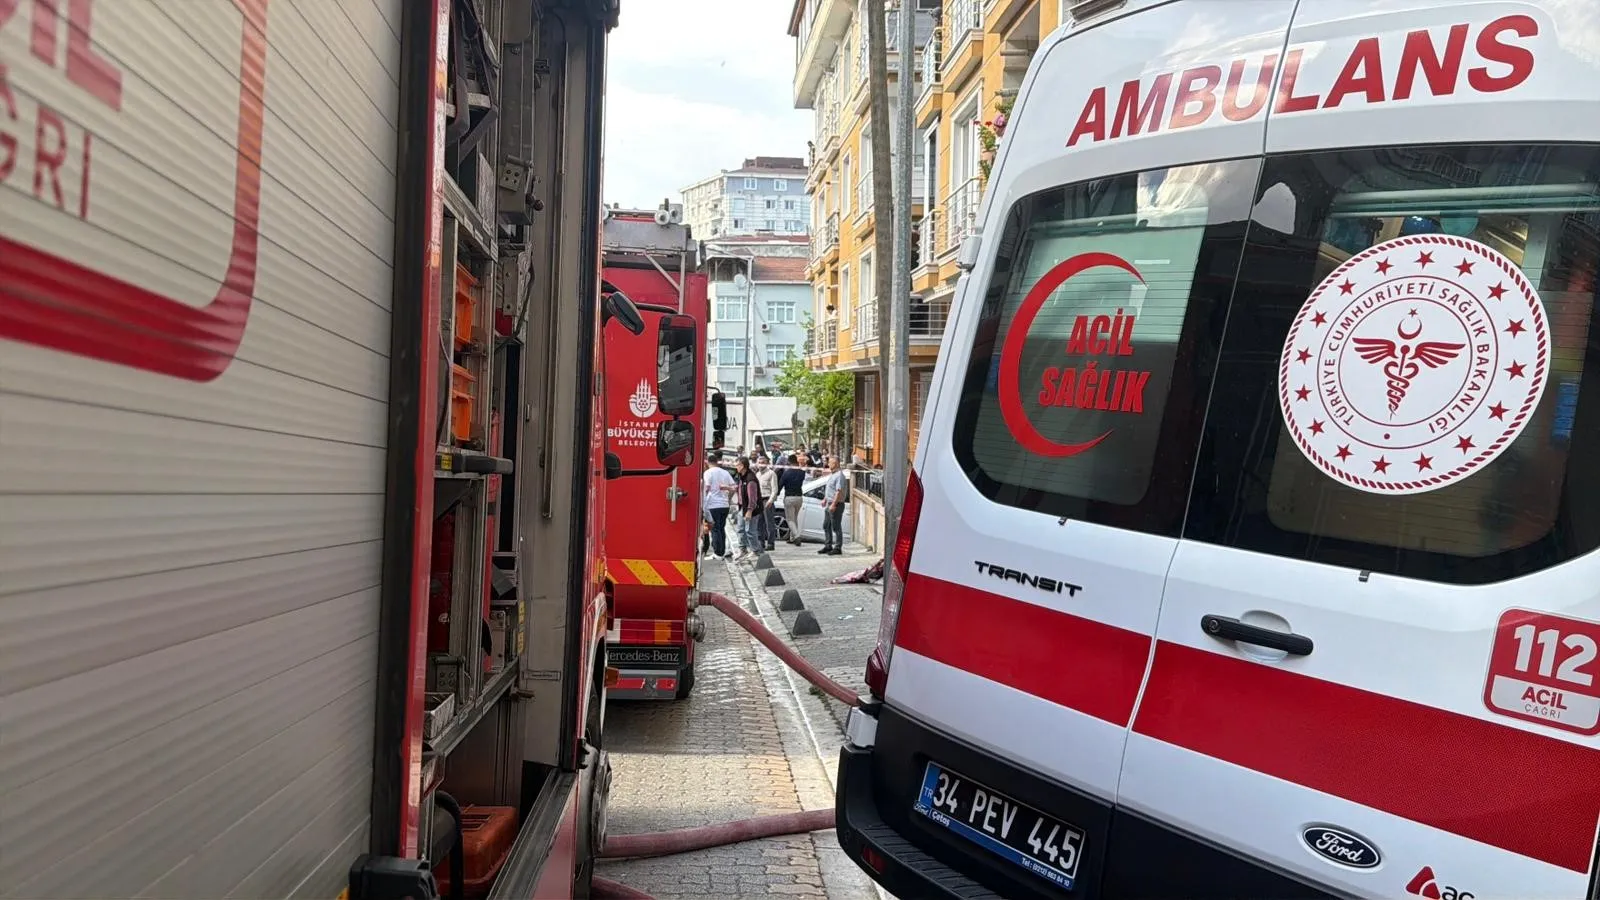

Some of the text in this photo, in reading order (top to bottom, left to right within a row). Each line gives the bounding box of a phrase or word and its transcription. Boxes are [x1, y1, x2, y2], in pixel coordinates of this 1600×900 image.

[1066, 15, 1538, 147] AMBULANS
[1066, 308, 1136, 356] ACİL
[1322, 281, 1489, 434] TÜRKİYE CUMHURİYETİ SAĞLIK BAKANLIĞI
[1039, 360, 1151, 413] SAĞLIK
[607, 426, 658, 439] BÜYÜKŞE
[974, 560, 1083, 598] TRANSIT
[1514, 624, 1598, 687] 112
[924, 786, 933, 798] TR
[933, 772, 1080, 870] 34 PEV 445
[1316, 831, 1365, 863] Ford
